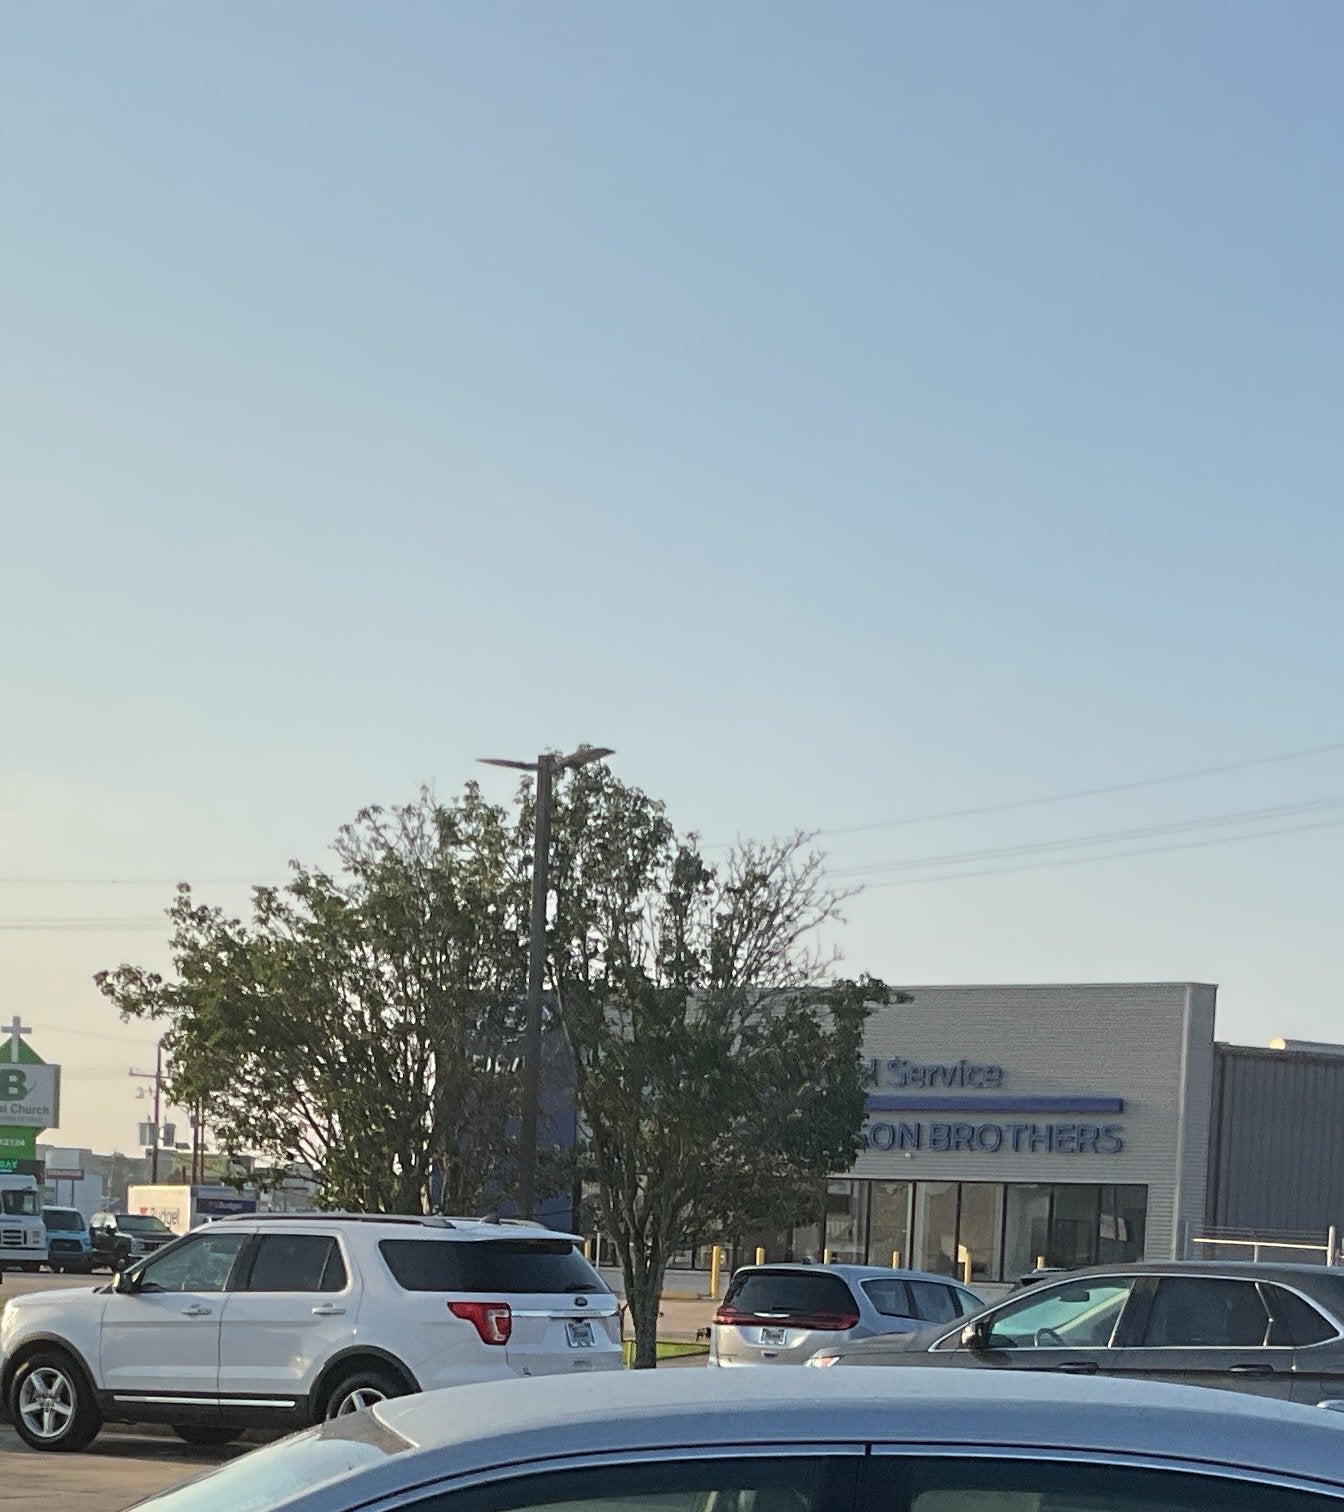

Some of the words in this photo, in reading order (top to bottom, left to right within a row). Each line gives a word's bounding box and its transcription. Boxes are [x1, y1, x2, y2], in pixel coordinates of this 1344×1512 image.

[886, 1055, 1004, 1089] Service
[10, 1103, 50, 1115] Church
[928, 1122, 1124, 1155] BROTHERS
